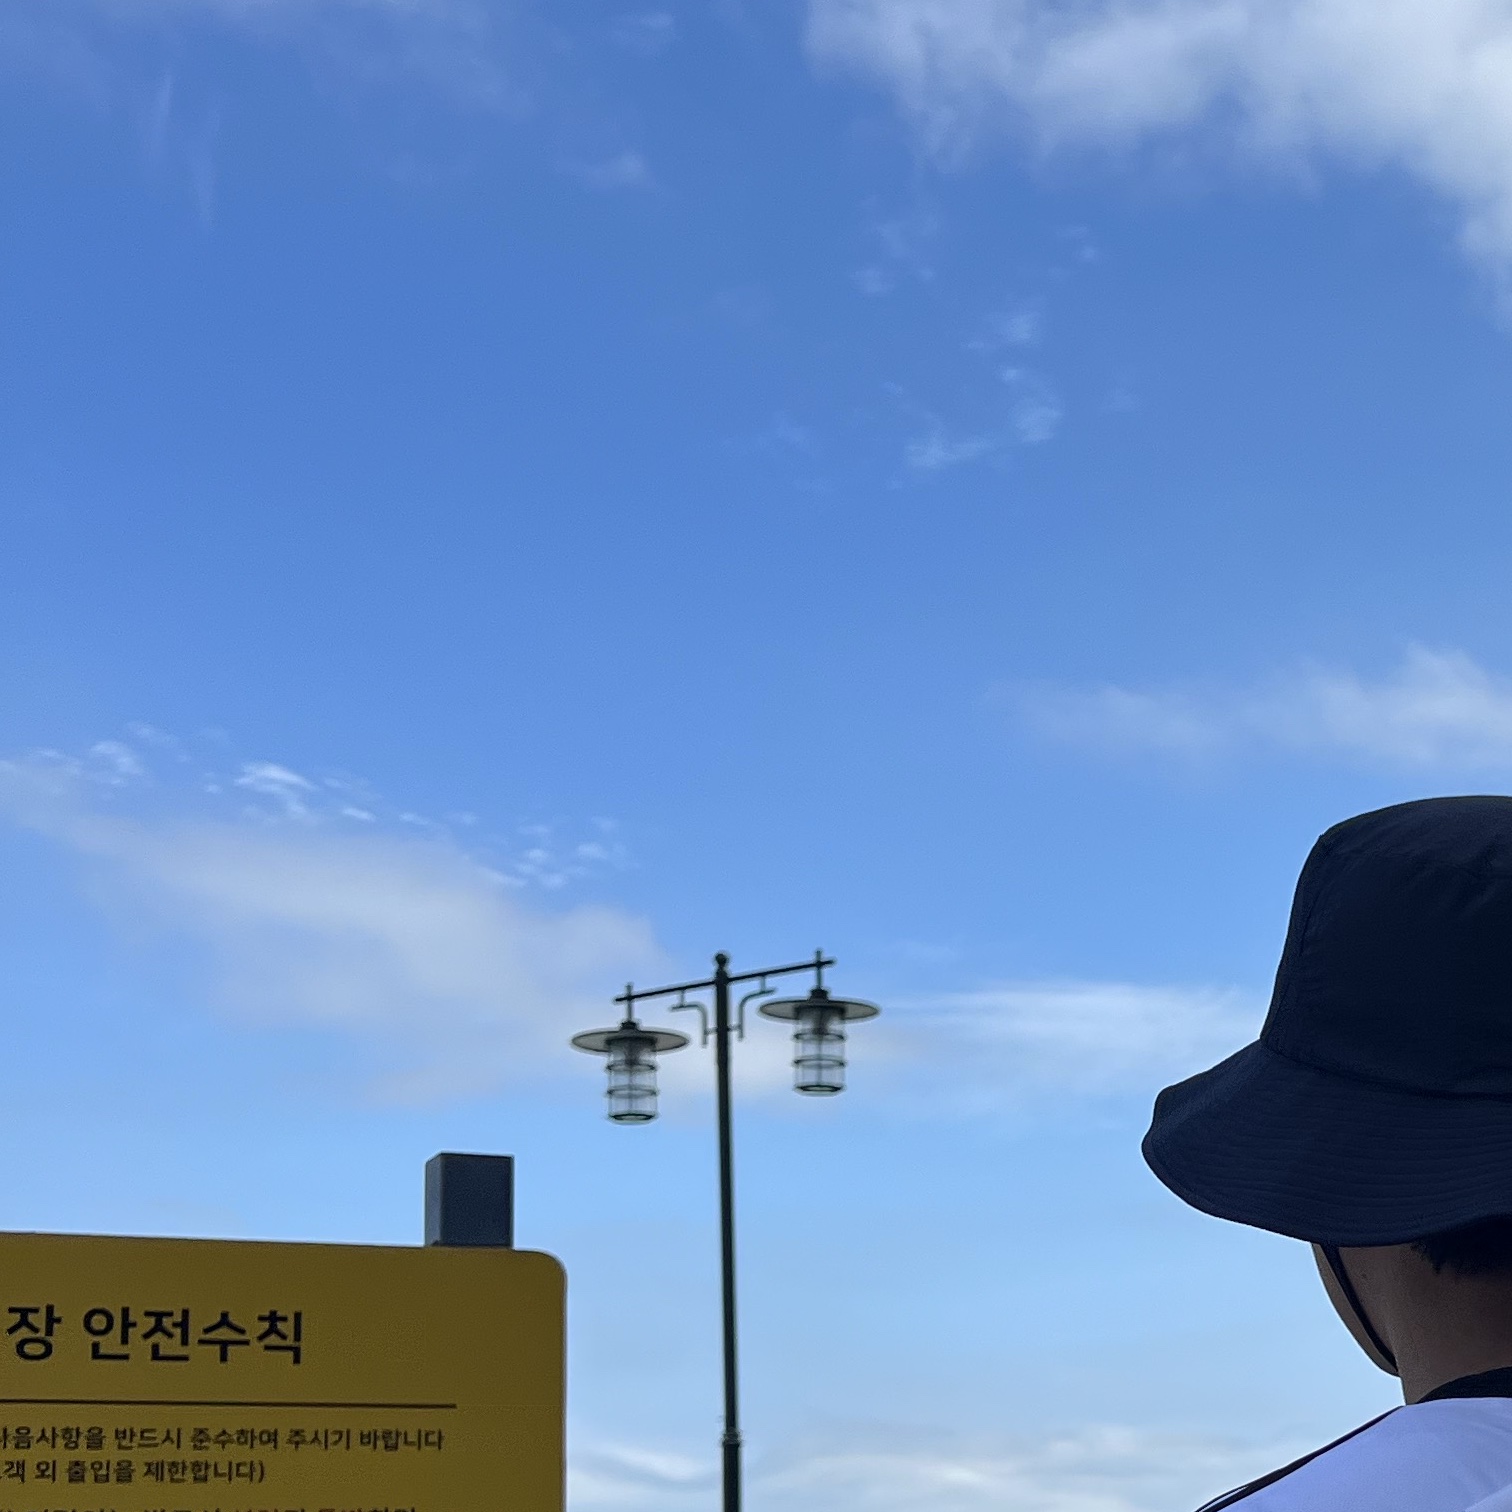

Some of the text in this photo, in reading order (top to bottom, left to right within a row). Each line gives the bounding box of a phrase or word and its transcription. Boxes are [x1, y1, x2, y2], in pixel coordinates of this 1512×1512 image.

[7, 1304, 304, 1365] 장 안전수칙
[114, 1426, 182, 1450] 반드시
[191, 1427, 279, 1451] 준수하며
[286, 1428, 351, 1450] 주시기
[358, 1428, 445, 1452] 바랍니다
[0, 1459, 266, 1484] 객 외 출입을 제한합니다)
